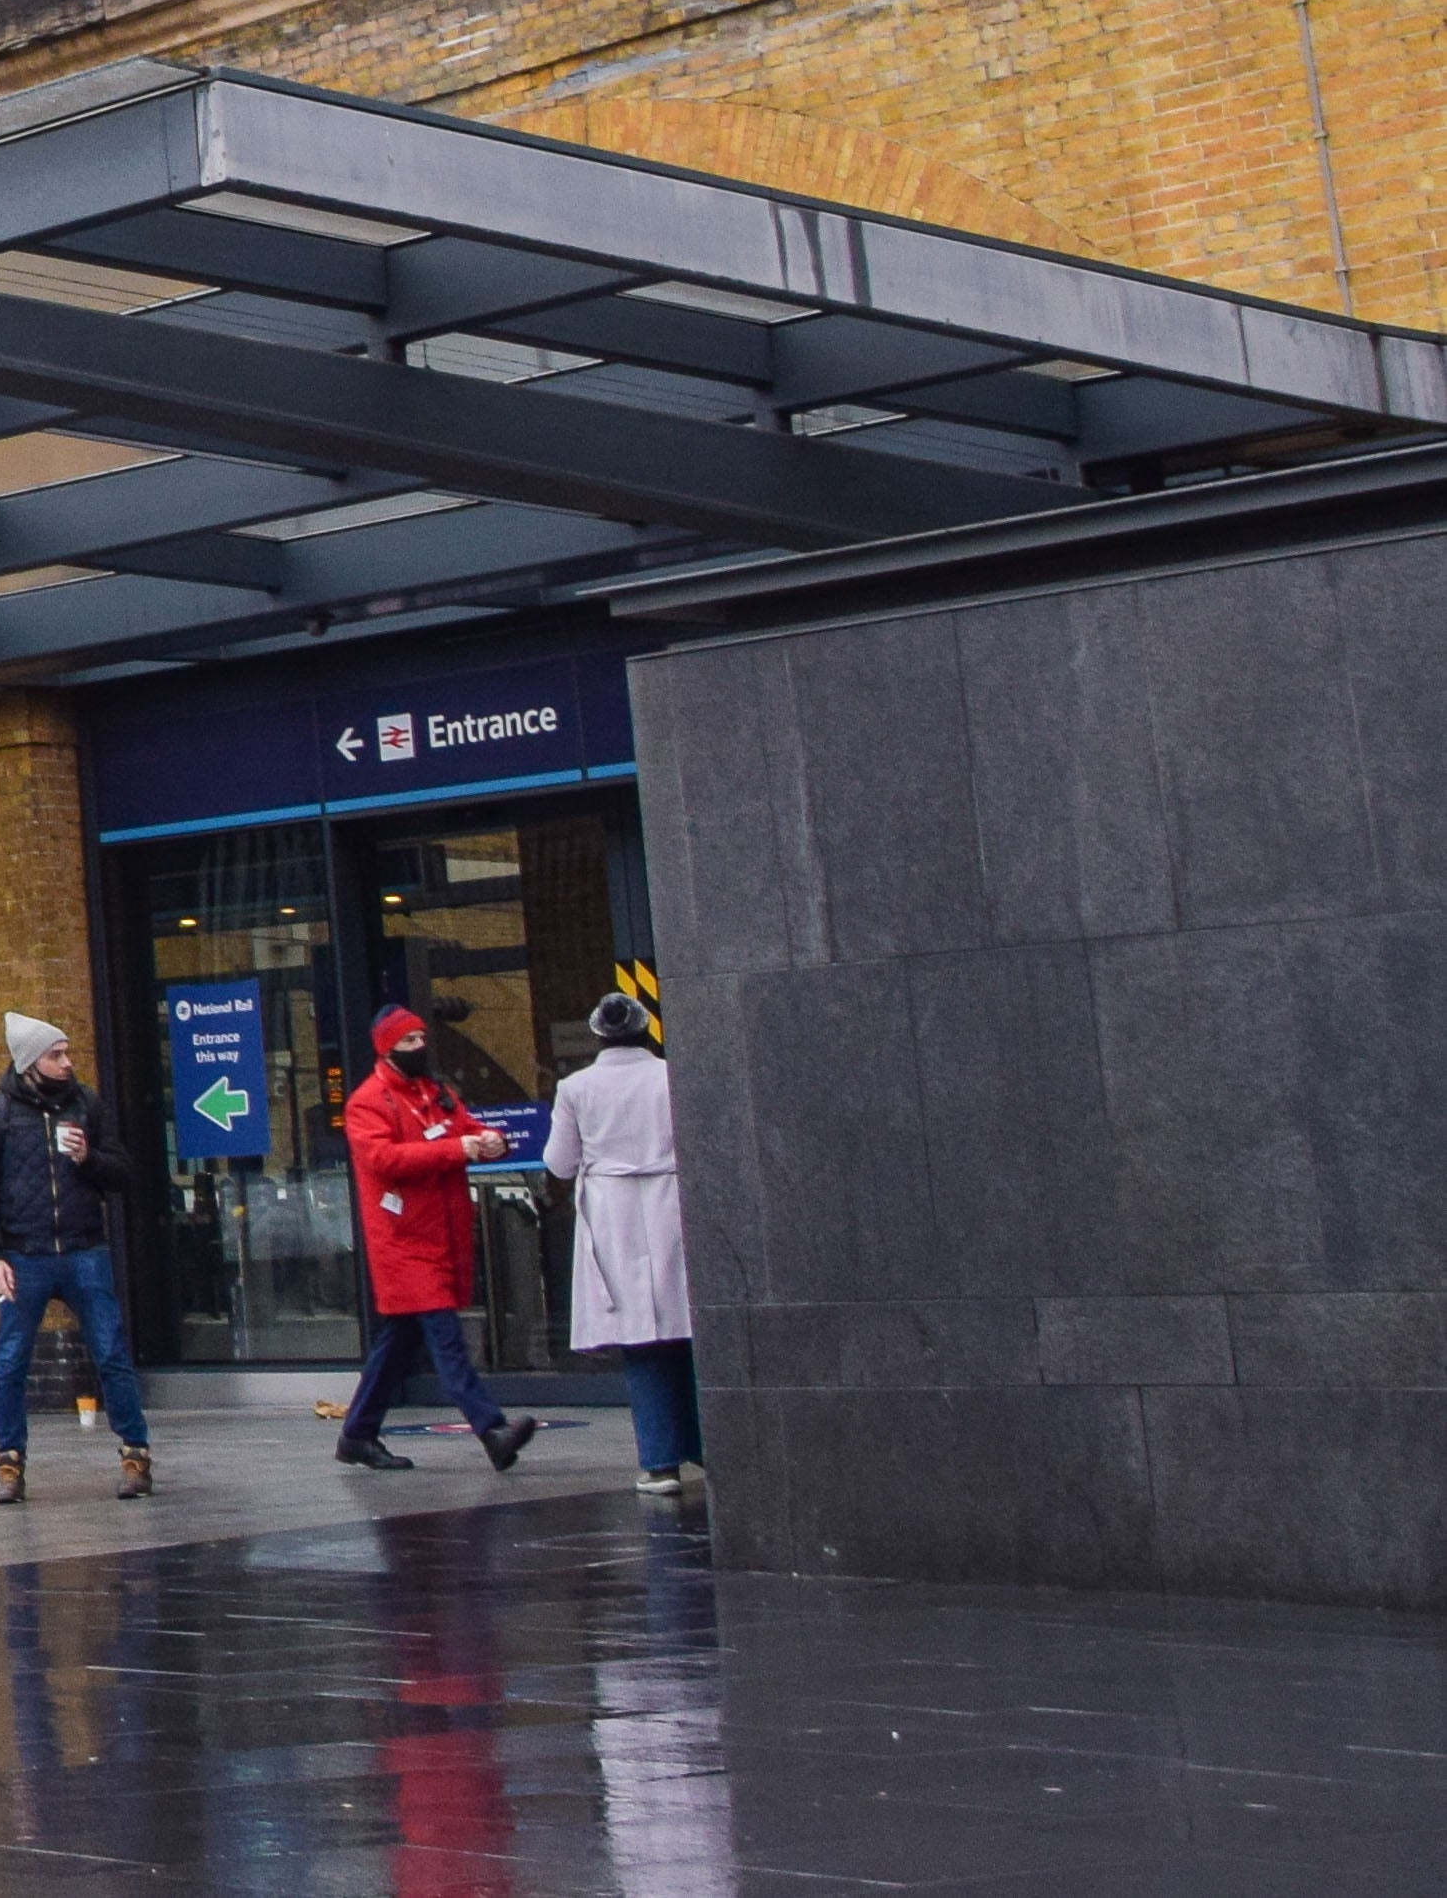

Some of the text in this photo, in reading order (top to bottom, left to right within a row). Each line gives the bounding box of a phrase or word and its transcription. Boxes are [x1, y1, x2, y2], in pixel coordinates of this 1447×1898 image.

[427, 706, 558, 748] Entrance
[192, 1000, 232, 1016] National
[192, 1033, 241, 1046] Entrance
[195, 1050, 240, 1063] this way
